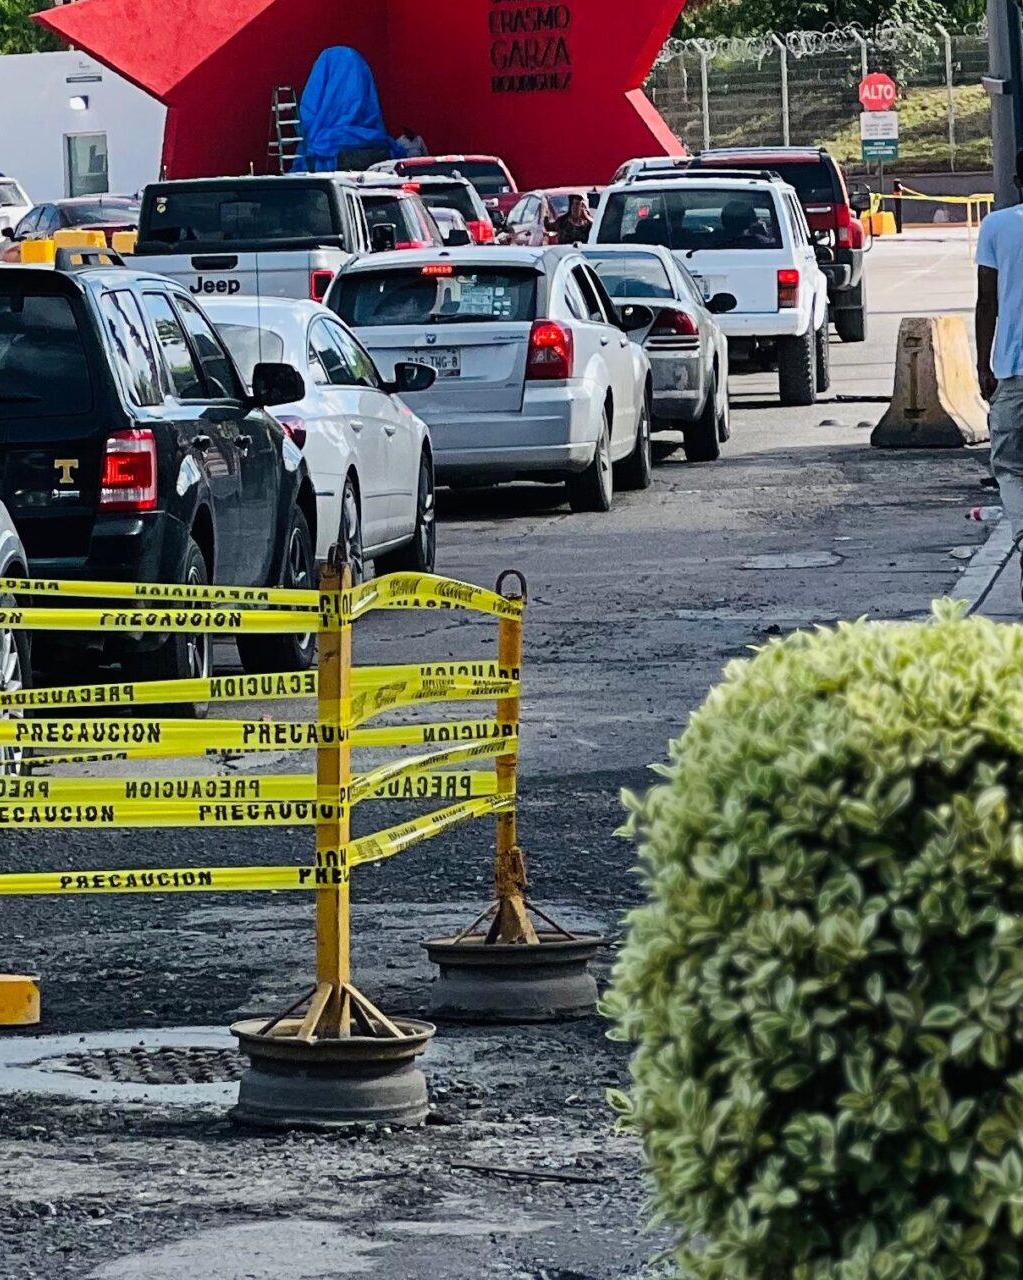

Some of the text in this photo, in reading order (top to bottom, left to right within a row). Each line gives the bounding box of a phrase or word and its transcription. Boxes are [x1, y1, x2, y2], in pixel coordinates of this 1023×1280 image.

[489, 5, 570, 34] ERASMO
[490, 37, 572, 69] GARZA
[862, 84, 894, 99] ALTO
[189, 276, 240, 295] Jeep
[54, 459, 79, 484] T
[16, 723, 161, 743] PRECAUCION
[60, 871, 213, 889] PRECAUCION
